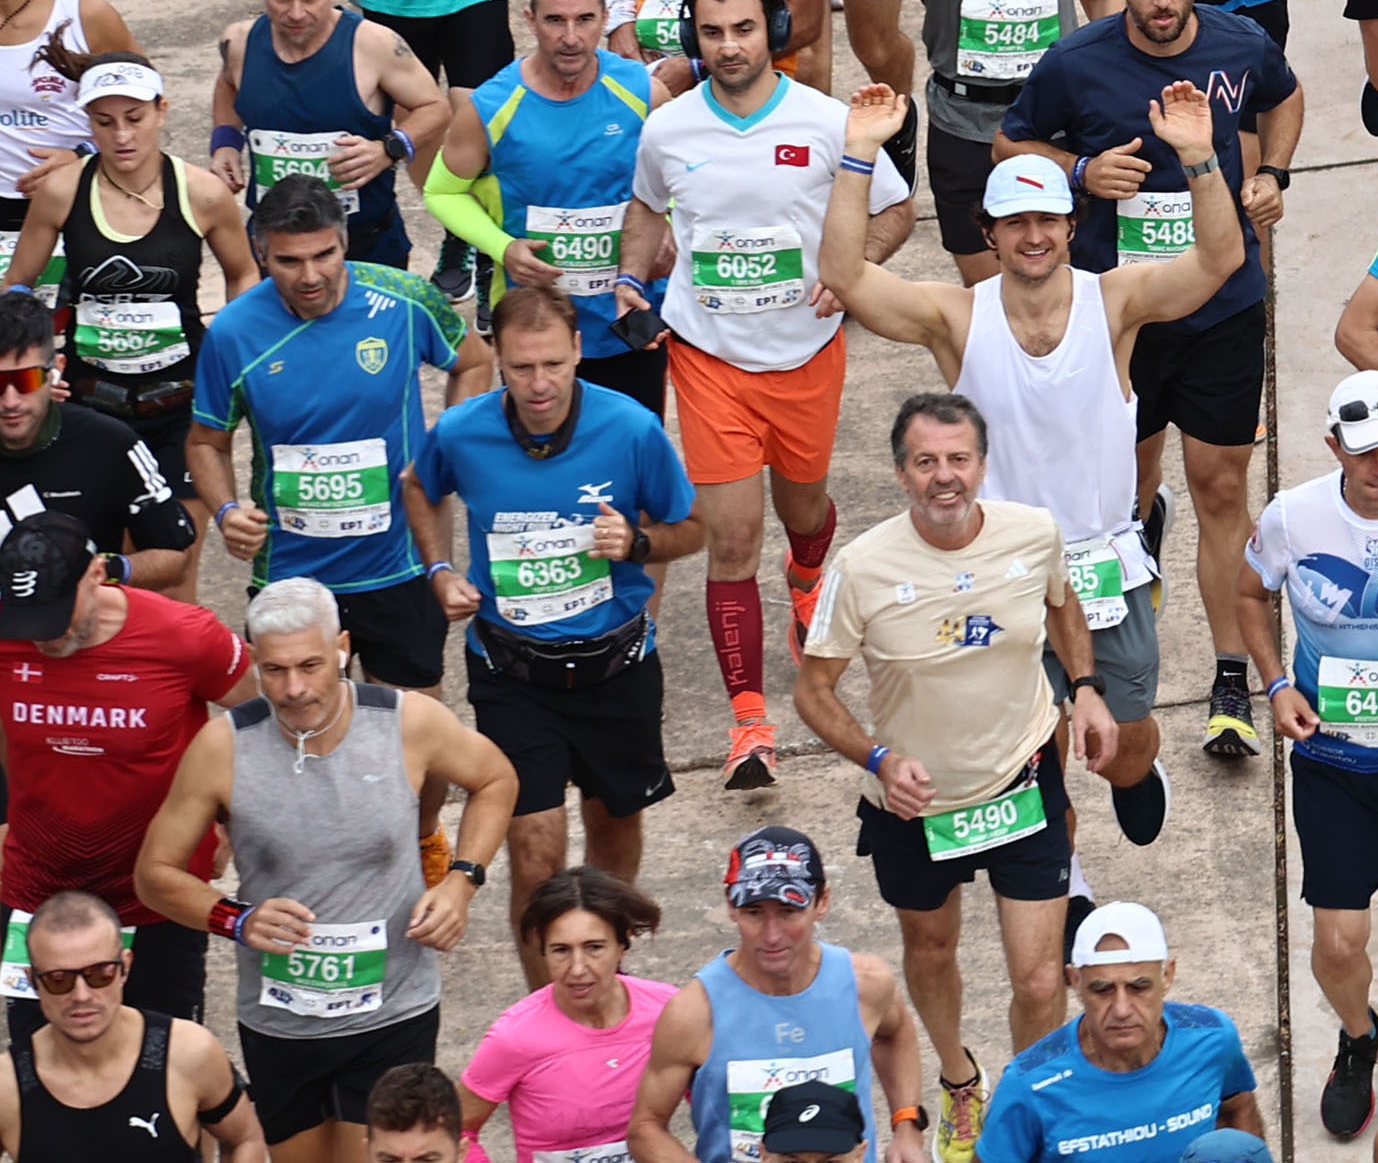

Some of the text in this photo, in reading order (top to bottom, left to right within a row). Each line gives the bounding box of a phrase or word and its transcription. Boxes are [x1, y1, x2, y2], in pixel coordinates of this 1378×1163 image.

[985, 22, 1039, 45] 5484
[552, 237, 611, 260] 6490
[716, 255, 777, 278] 6052
[299, 474, 363, 499] 5695
[517, 558, 581, 586] 6363
[12, 704, 147, 728] DENMARK
[953, 800, 1016, 837] 5490
[287, 951, 355, 980] 5761
[1058, 1120, 1156, 1154] EFSTATHIOU
[1167, 1105, 1213, 1132] SOUND
